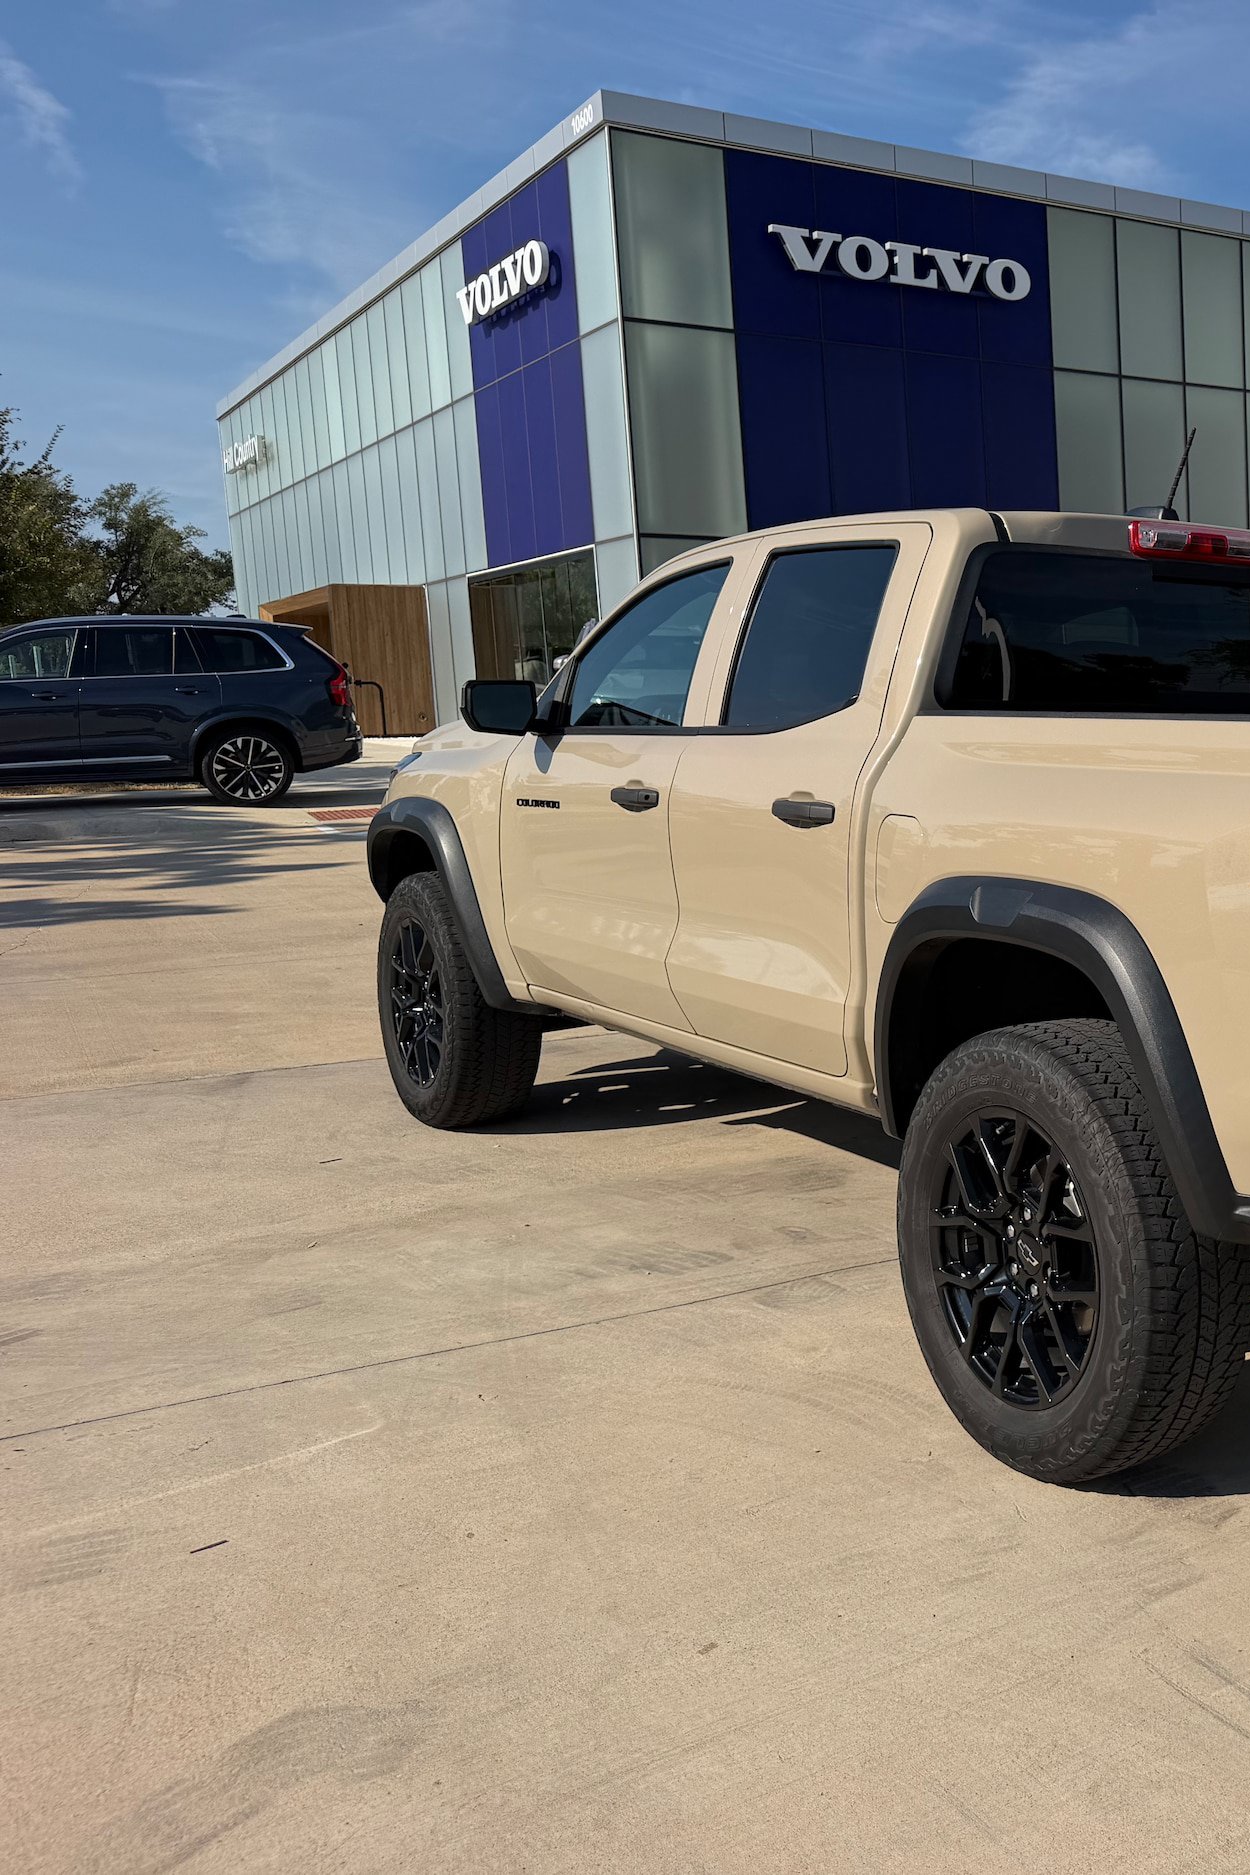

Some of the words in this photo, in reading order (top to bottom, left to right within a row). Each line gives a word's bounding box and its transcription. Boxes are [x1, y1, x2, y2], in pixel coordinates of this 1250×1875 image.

[571, 103, 593, 136] 10600
[456, 239, 545, 326] VOLVO
[768, 223, 1031, 301] VOLVO
[516, 798, 560, 810] COLORADO
